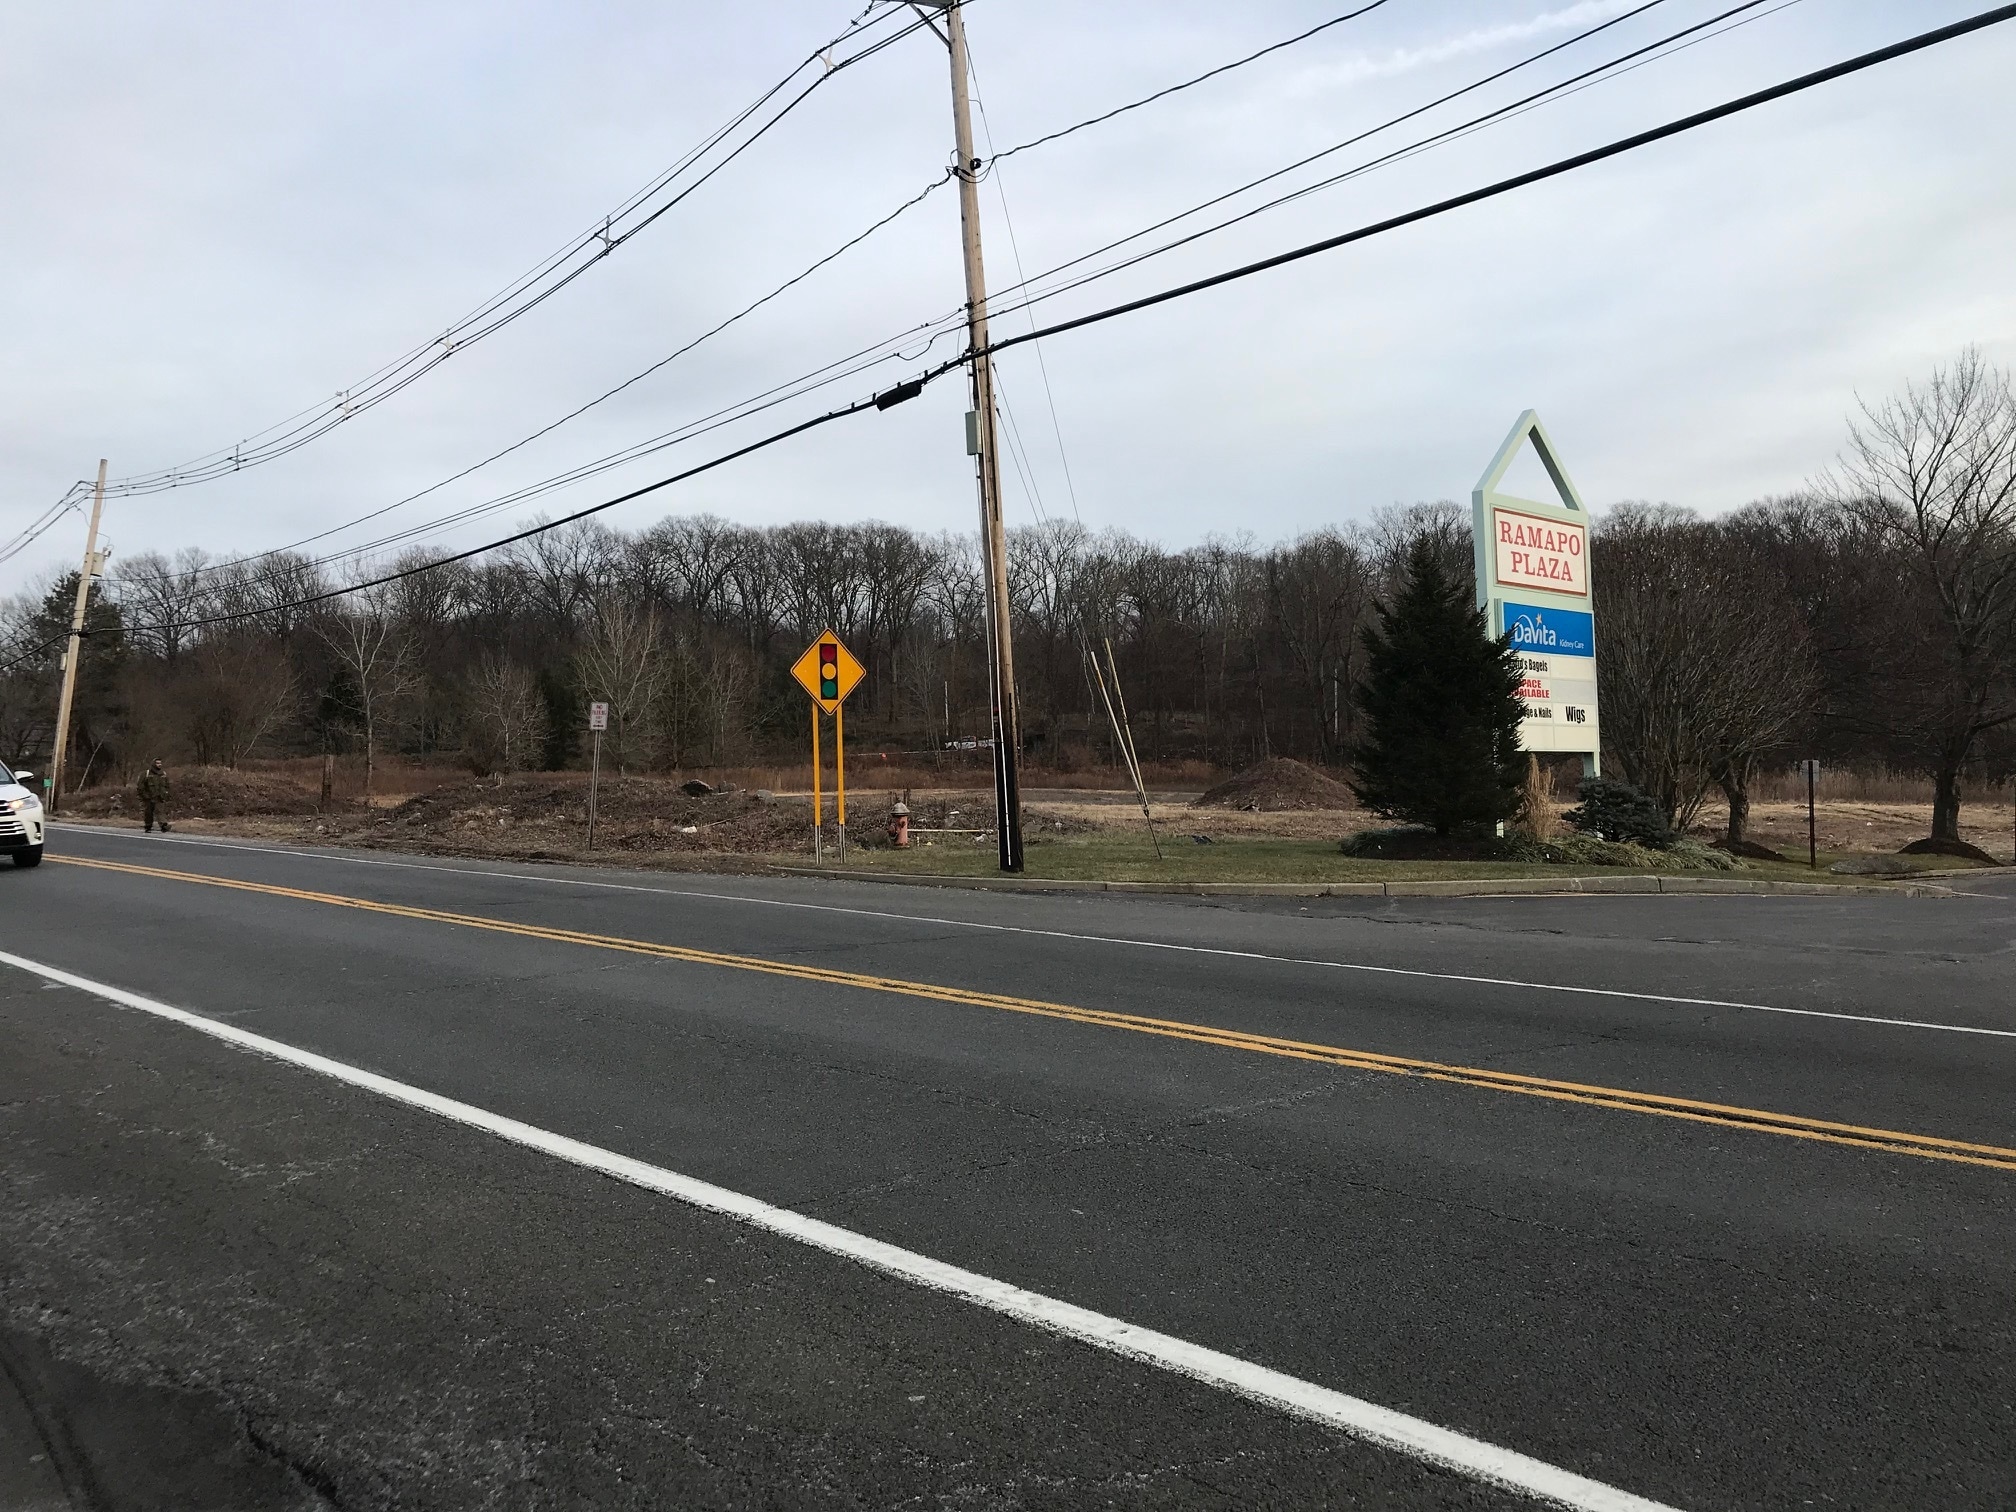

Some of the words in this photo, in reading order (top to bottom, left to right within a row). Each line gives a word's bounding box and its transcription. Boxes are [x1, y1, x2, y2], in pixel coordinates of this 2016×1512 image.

[1499, 520, 1581, 556] RAMAPO
[1511, 551, 1573, 582] PLAZA
[1560, 639, 1574, 649] Kidney
[1574, 641, 1584, 649] Care
[1529, 658, 1548, 672] Bagels
[1520, 679, 1541, 688] PACE
[1513, 689, 1550, 698] AILABLE
[1538, 707, 1552, 718] Nails
[1565, 706, 1586, 724] Wigs
